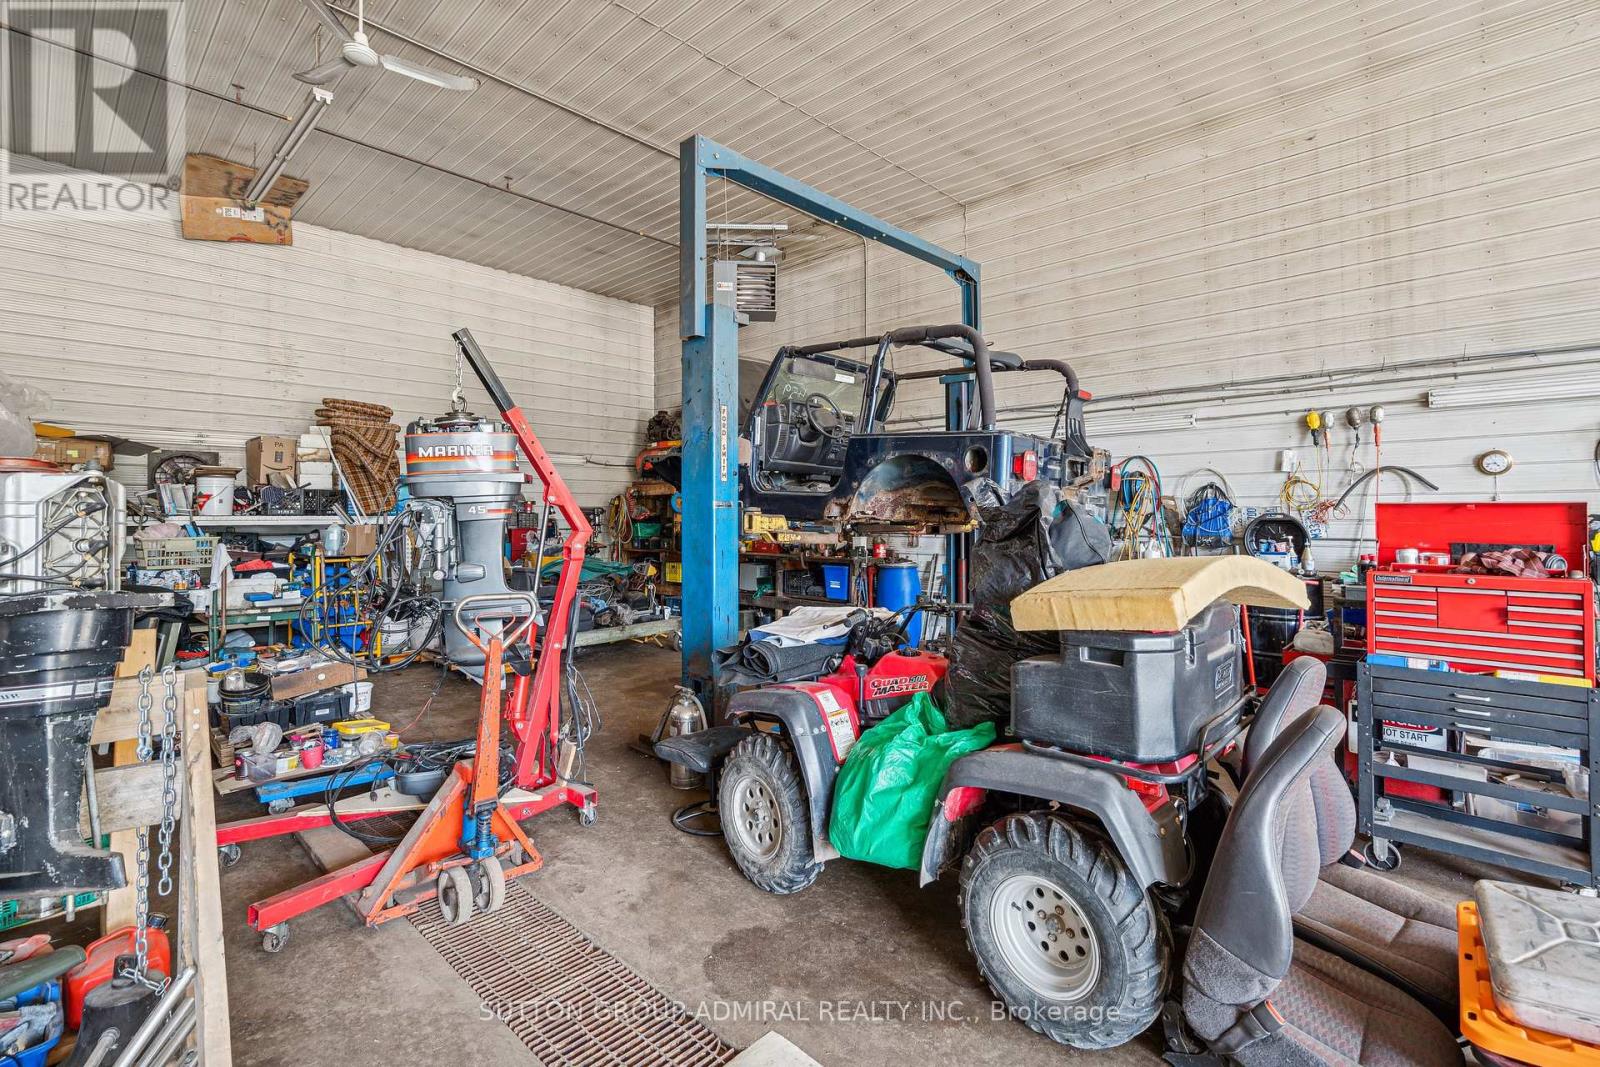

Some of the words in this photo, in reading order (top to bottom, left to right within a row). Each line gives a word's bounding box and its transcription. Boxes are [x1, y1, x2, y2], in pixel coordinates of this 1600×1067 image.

[418, 445, 494, 458] MARINER
[468, 505, 487, 515] 45
[872, 682, 929, 697] MASTER
[1400, 731, 1429, 743] START
